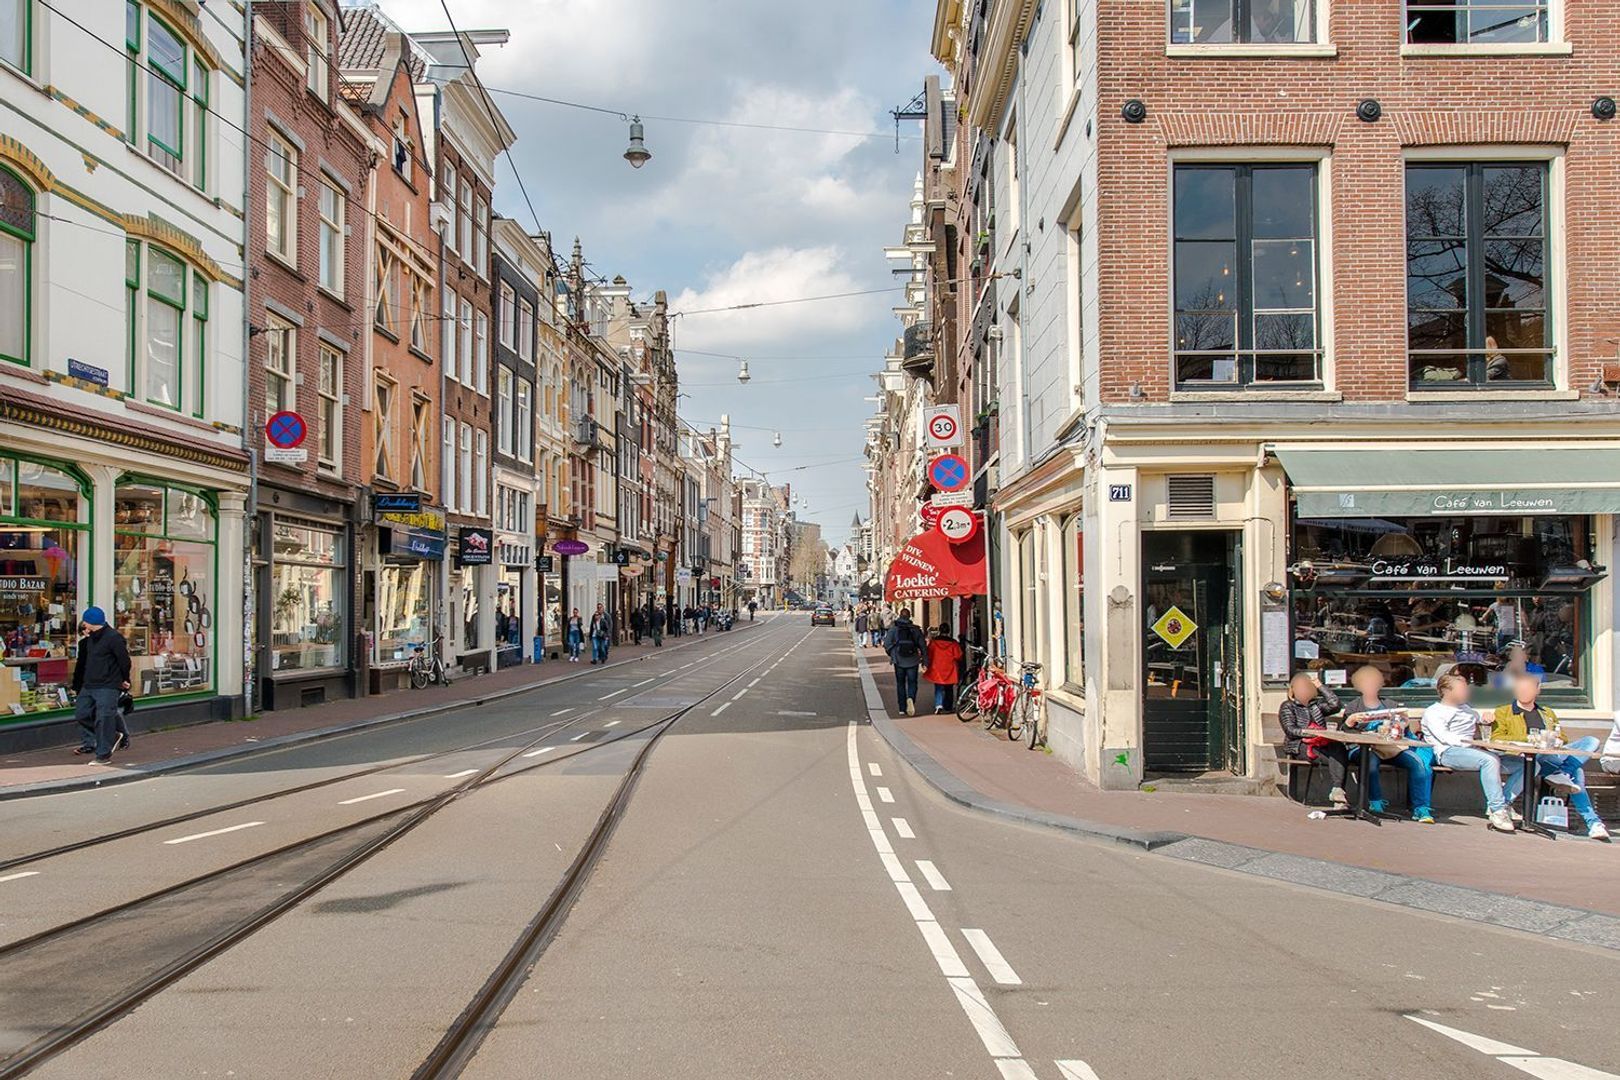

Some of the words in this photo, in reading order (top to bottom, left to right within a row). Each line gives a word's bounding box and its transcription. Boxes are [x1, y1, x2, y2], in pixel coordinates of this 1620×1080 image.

[934, 422, 953, 433] 30
[1112, 487, 1129, 499] 711
[1433, 495, 1467, 508] Café
[1473, 499, 1493, 508] van
[1500, 492, 1554, 508] Leeuwen
[1371, 560, 1410, 575] Café
[1416, 565, 1438, 575] van
[1445, 557, 1505, 575] Leeuwen
[894, 587, 949, 599] CATERING
